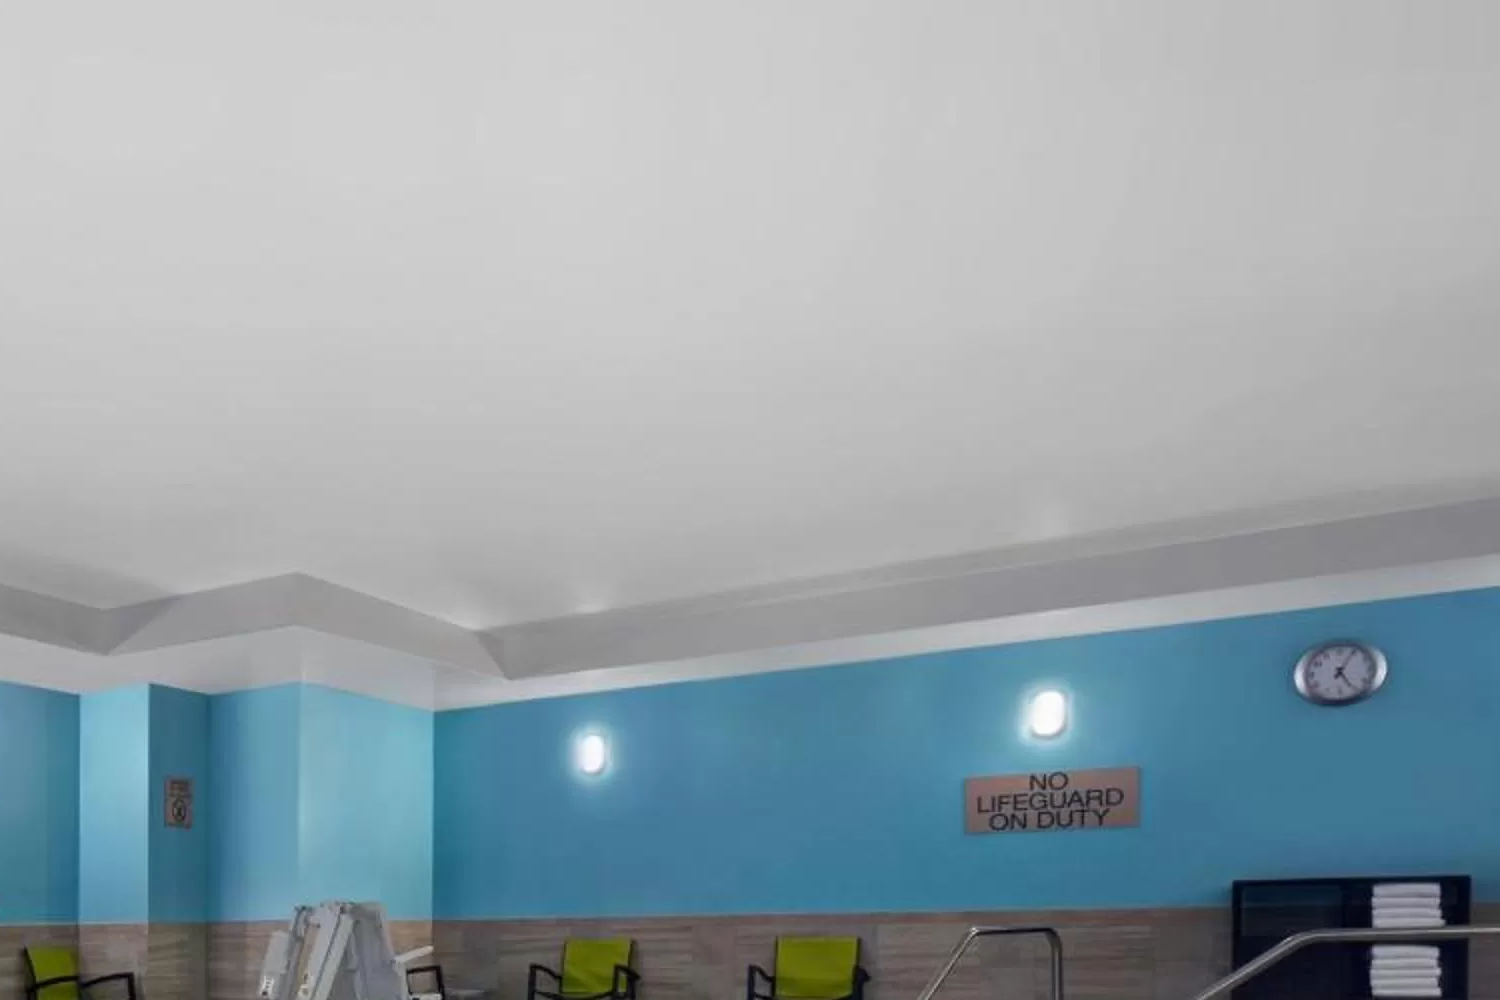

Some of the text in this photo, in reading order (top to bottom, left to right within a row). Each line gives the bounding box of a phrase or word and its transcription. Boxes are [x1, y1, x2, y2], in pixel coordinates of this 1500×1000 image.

[1029, 771, 1069, 791] NO
[977, 787, 1125, 814] LIFEGUARD
[988, 808, 1112, 832] ON DUTY
